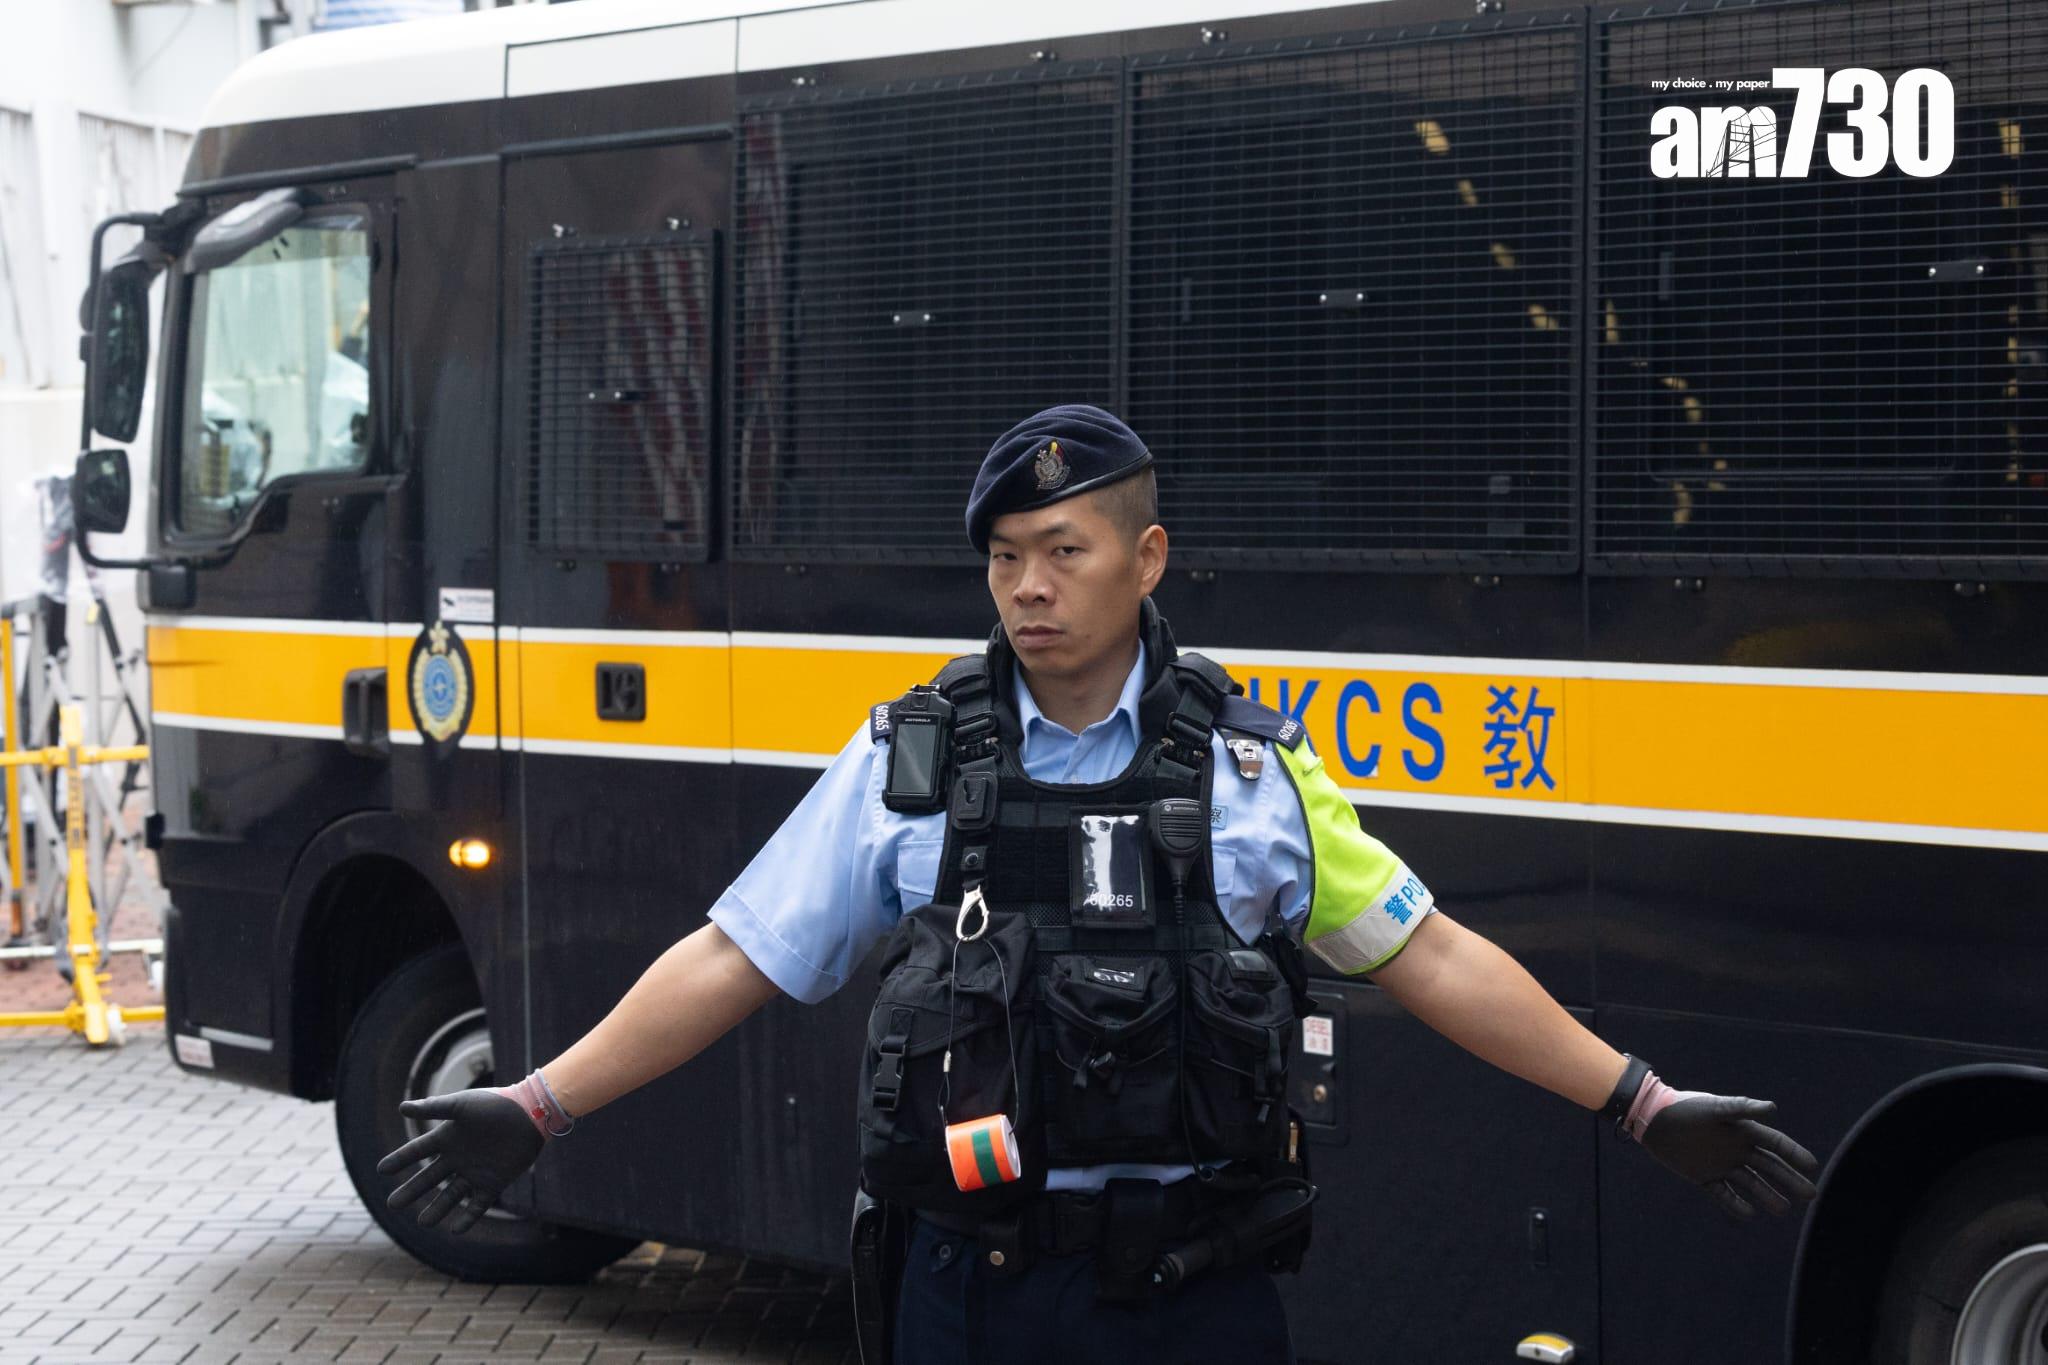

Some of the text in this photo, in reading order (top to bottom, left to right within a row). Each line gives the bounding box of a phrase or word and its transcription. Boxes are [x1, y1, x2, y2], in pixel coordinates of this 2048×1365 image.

[875, 705, 889, 731] 60265
[1250, 678, 1445, 782] KCS
[1278, 719, 1298, 740] 60265
[1400, 875, 1426, 906] PO
